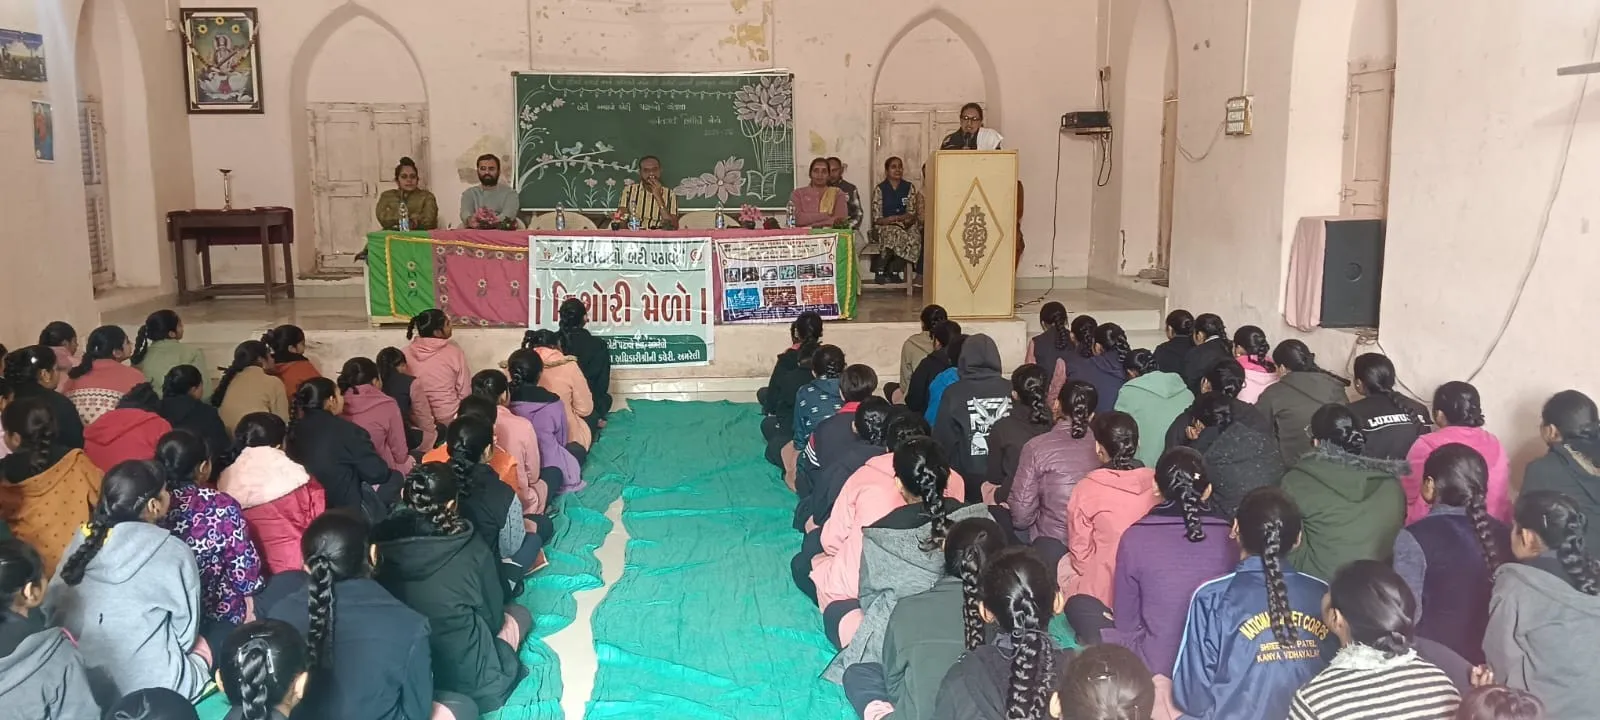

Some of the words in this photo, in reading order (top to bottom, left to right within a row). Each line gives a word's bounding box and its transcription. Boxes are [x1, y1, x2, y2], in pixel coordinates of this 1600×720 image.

[552, 280, 631, 323] િશોરી
[1303, 615, 1329, 640] CORPS
[1296, 639, 1317, 648] PATEL
